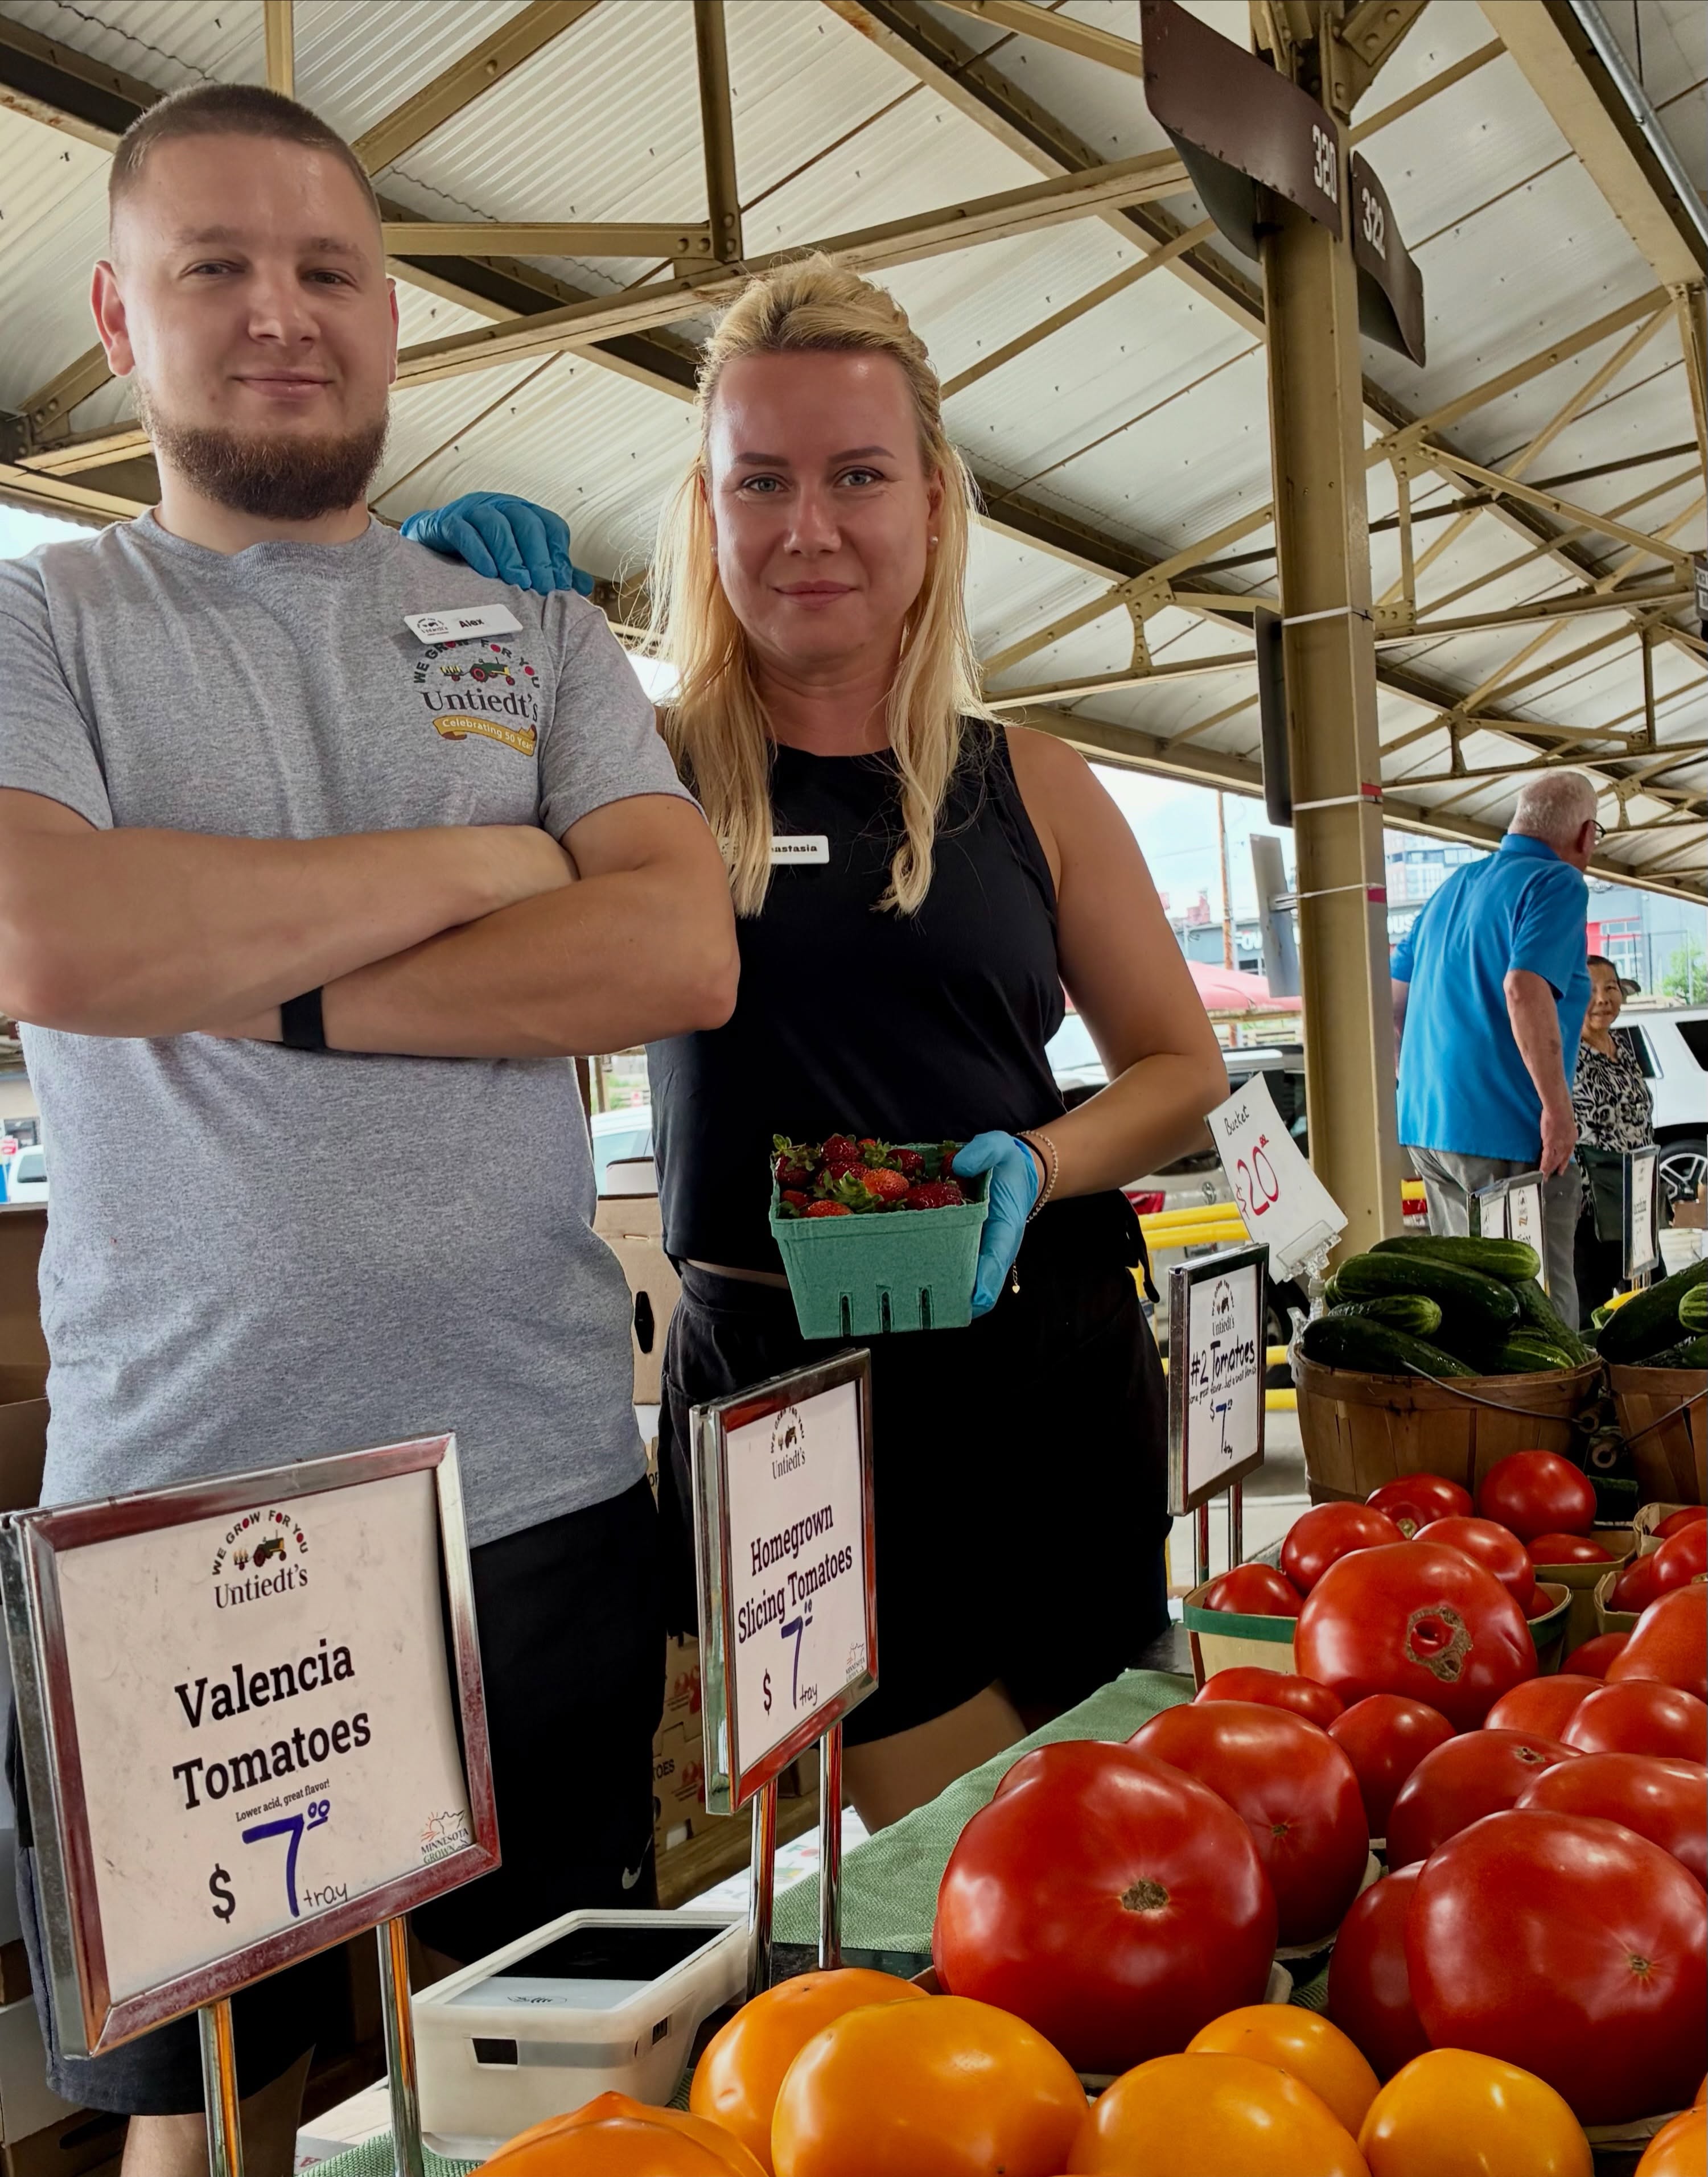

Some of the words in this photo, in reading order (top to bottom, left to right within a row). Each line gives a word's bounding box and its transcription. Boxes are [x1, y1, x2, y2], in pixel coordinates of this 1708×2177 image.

[1312, 124, 1337, 204] 320
[414, 661, 430, 683] WE
[480, 638, 512, 659] FOR
[519, 657, 540, 688] YOU
[420, 688, 538, 722] Untiedt's
[442, 718, 502, 738] Celebrating
[505, 731, 515, 743] 50
[1190, 1349, 1208, 1386] #2
[1211, 1334, 1255, 1381] Tomatoes
[772, 1447, 805, 1480] Untiedt's
[212, 1548, 227, 1576] WE
[225, 1511, 261, 1544] GROW
[269, 1510, 291, 1528] FOR
[293, 1524, 308, 1554] YOU
[751, 1504, 833, 1576] Homegrown
[214, 1564, 308, 1609] Untiedt's
[738, 1585, 785, 1644] Slicing
[788, 1544, 853, 1607] Tomatoes
[174, 1638, 355, 1729] Valencia
[800, 1682, 818, 1706] tray
[172, 1712, 371, 1810] Tomatoes
[236, 1805, 262, 1822] Lower
[263, 1796, 283, 1812] acid,
[283, 1789, 304, 1806] great
[304, 1779, 331, 1796] flavor!
[421, 1828, 469, 1854] MINNESOTA
[423, 1845, 455, 1865] GROWN
[208, 1863, 236, 1924] $
[303, 1883, 348, 1908] tray
